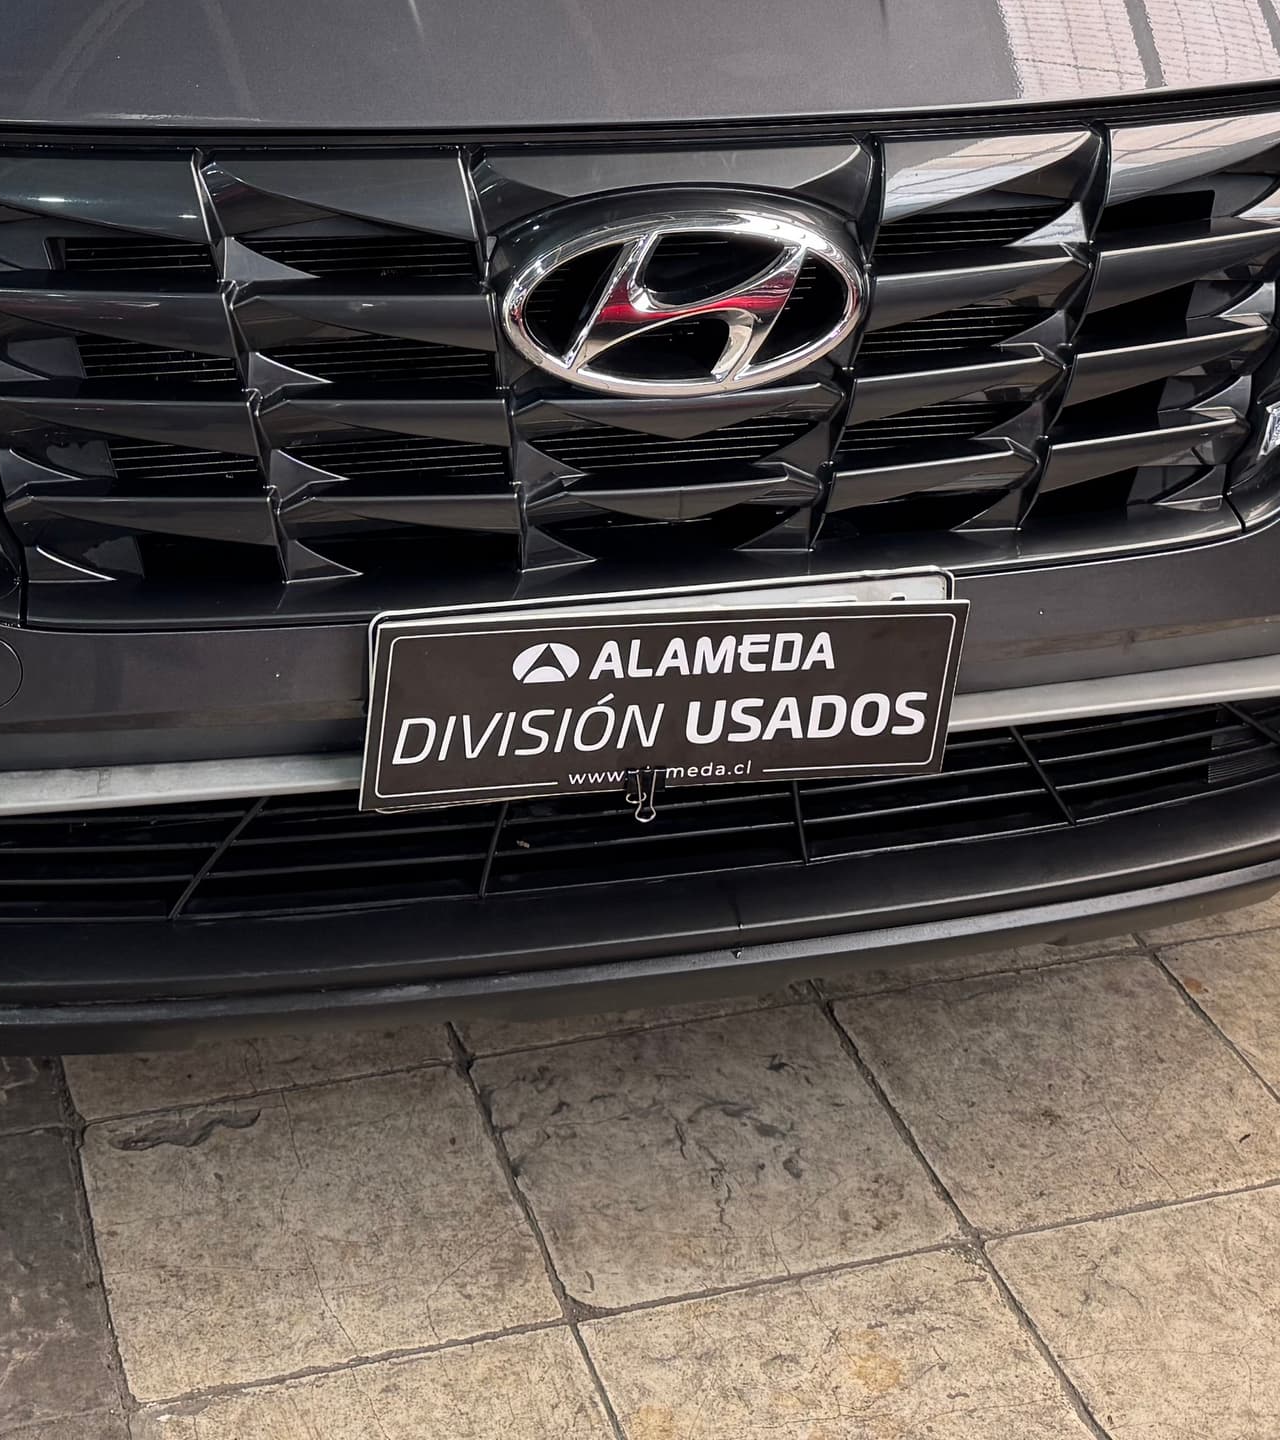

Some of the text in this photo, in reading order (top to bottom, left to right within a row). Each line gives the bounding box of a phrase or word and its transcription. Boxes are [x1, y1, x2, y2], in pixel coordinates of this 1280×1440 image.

[589, 632, 835, 680] ALAMEDA
[392, 692, 927, 765] DIVISIÓN USADOS
